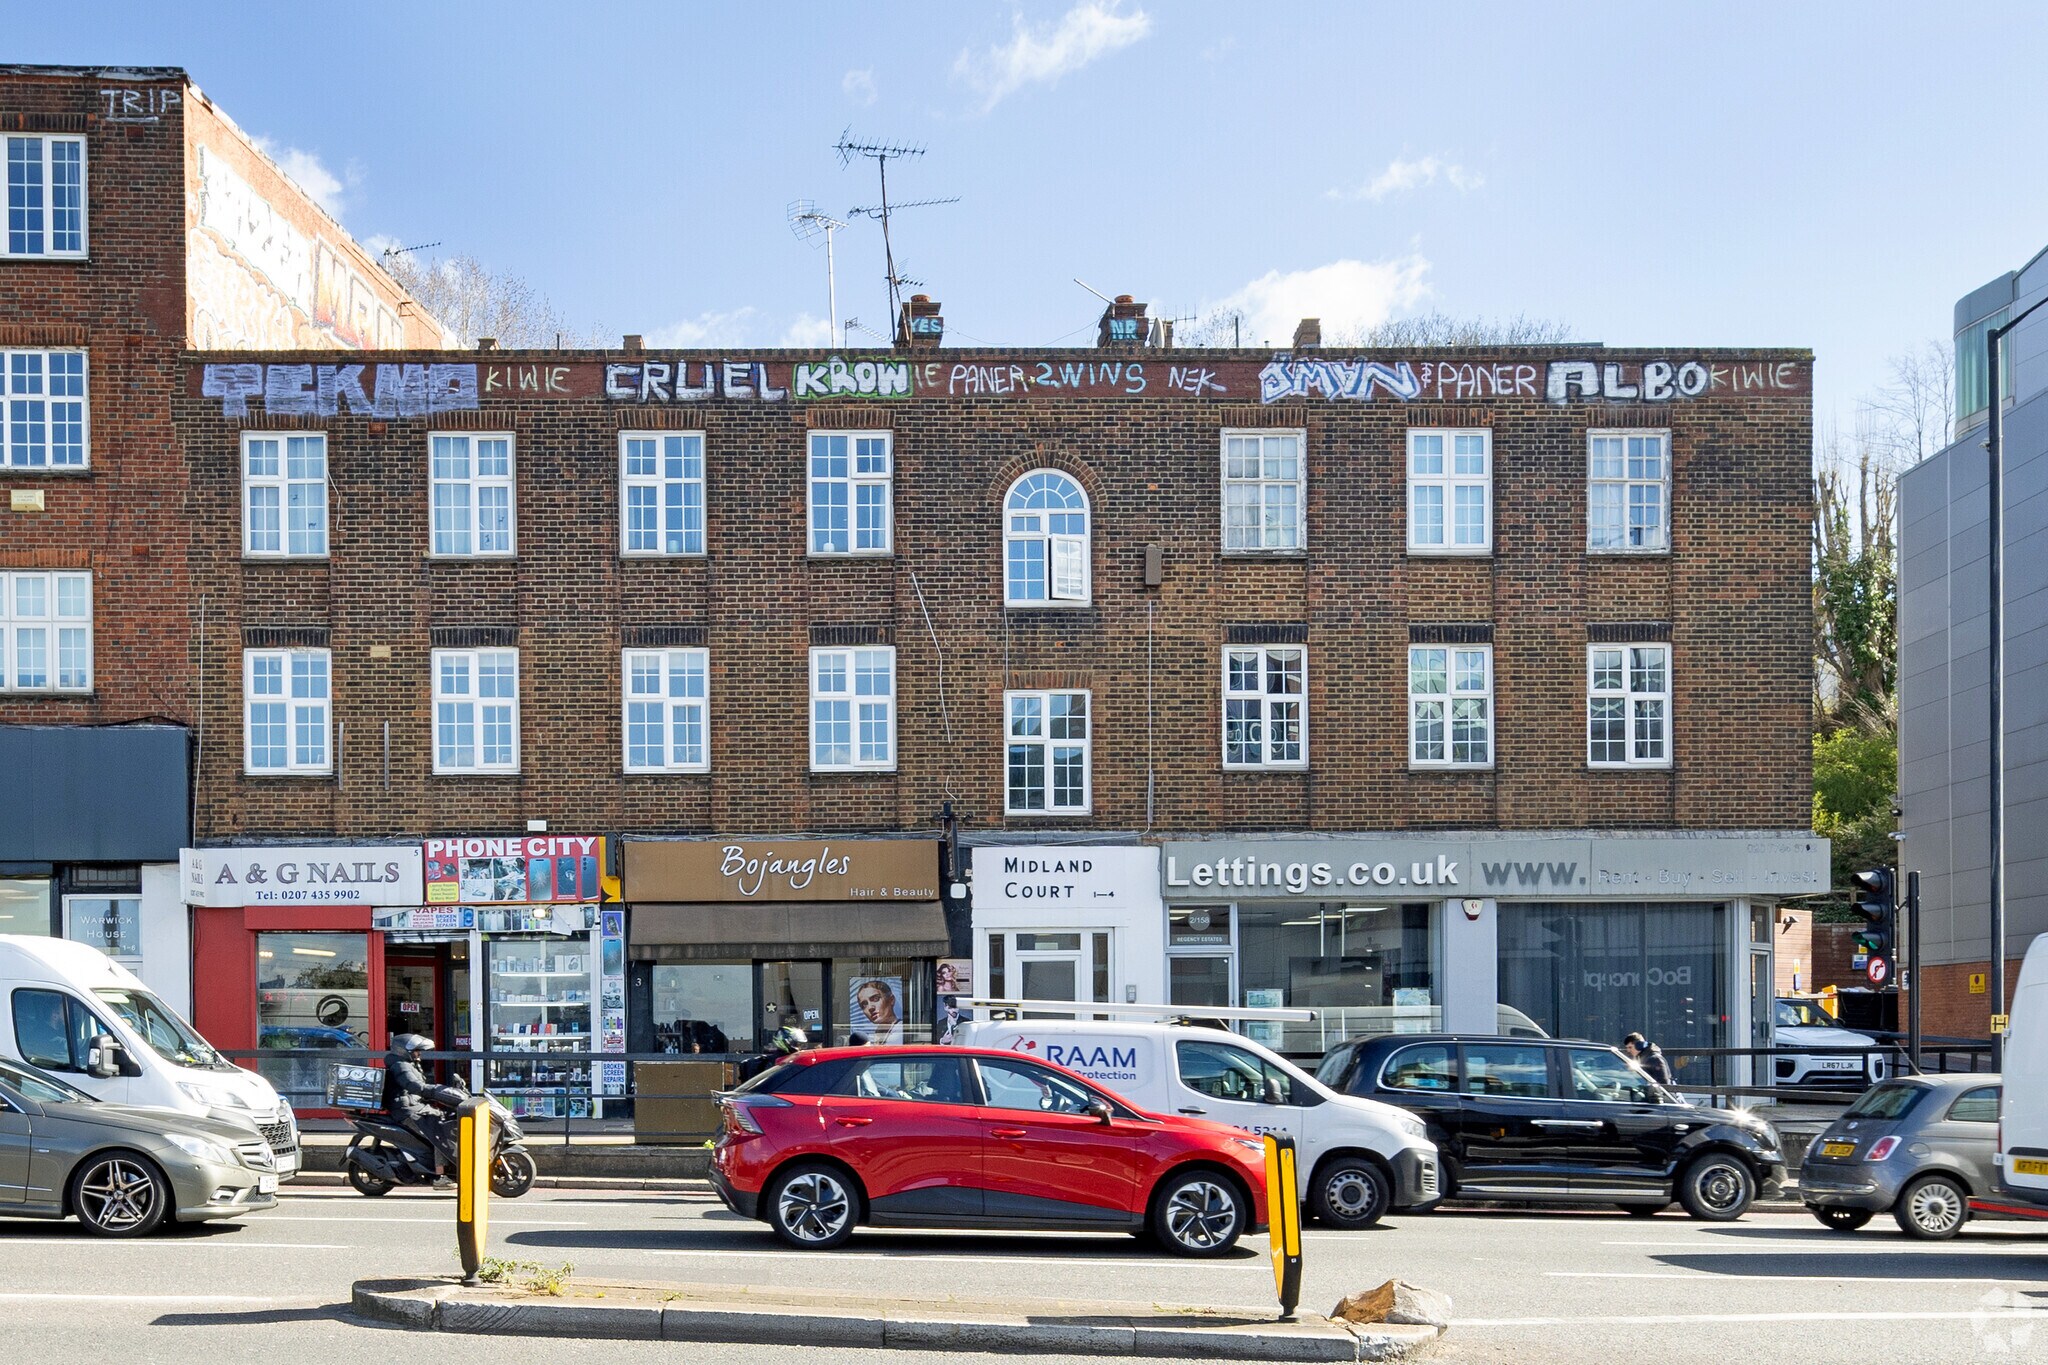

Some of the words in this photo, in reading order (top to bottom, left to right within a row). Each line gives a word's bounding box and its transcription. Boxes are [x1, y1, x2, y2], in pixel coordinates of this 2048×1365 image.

[101, 88, 182, 116] TRIP
[909, 317, 942, 334] YES
[485, 364, 571, 394] KIWIE
[1438, 362, 1537, 399] PANER
[1545, 360, 1707, 404] ALBO
[1710, 362, 1799, 392] KIWIE
[428, 838, 522, 858] PHONE
[527, 837, 597, 856] CITY
[215, 863, 238, 884] A
[245, 862, 268, 884] &
[276, 862, 300, 885] G
[306, 862, 401, 884] NAILS
[720, 846, 851, 896] Bojangles
[1167, 854, 1460, 893] Lettings.co.uk
[1598, 869, 1640, 884] Rent
[1658, 869, 1691, 889] Buy
[255, 890, 279, 900] Tel:
[281, 890, 308, 900] 0207
[311, 890, 337, 900] 435
[334, 890, 361, 900] 9902
[850, 887, 875, 897] Hair
[880, 888, 888, 897] &
[893, 887, 935, 899] Beauty
[1190, 916, 1210, 924] 2/158
[635, 977, 642, 986] 3
[402, 1003, 418, 1011] OPEN
[803, 1009, 819, 1020] OPEN
[1046, 1045, 1136, 1068] RAAM
